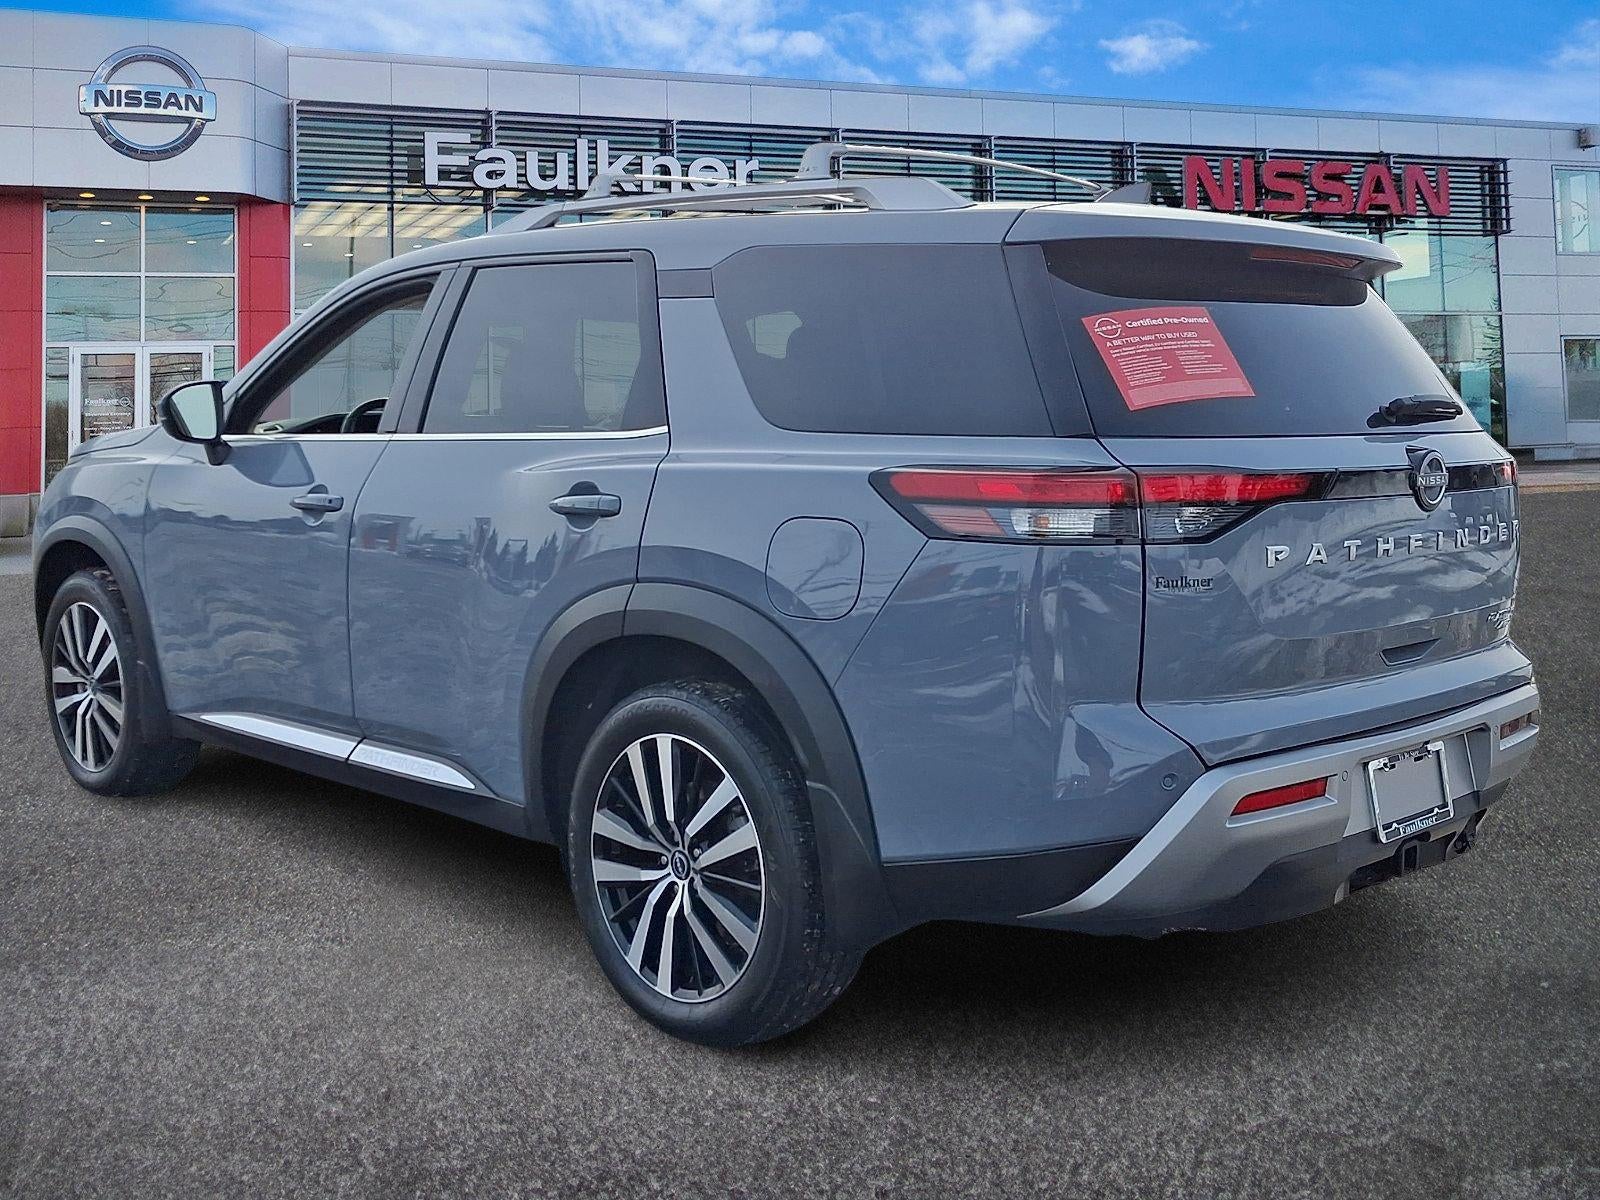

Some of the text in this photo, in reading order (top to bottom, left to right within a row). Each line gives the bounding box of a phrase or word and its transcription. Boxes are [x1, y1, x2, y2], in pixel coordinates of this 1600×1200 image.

[93, 89, 203, 113] NISSAN
[423, 131, 760, 193] Faulkner
[1182, 155, 1450, 216] NISSAN
[1095, 323, 1122, 333] NISSAN
[1126, 316, 1209, 327] Certified Pre-Owned
[1113, 336, 1140, 346] BETTER
[1140, 334, 1155, 342] WAY
[1266, 520, 1519, 568] PATHFINDER
[1154, 576, 1214, 588] Faulkner
[358, 748, 441, 778] PATHFINDER
[1399, 816, 1438, 834] Faulkner
